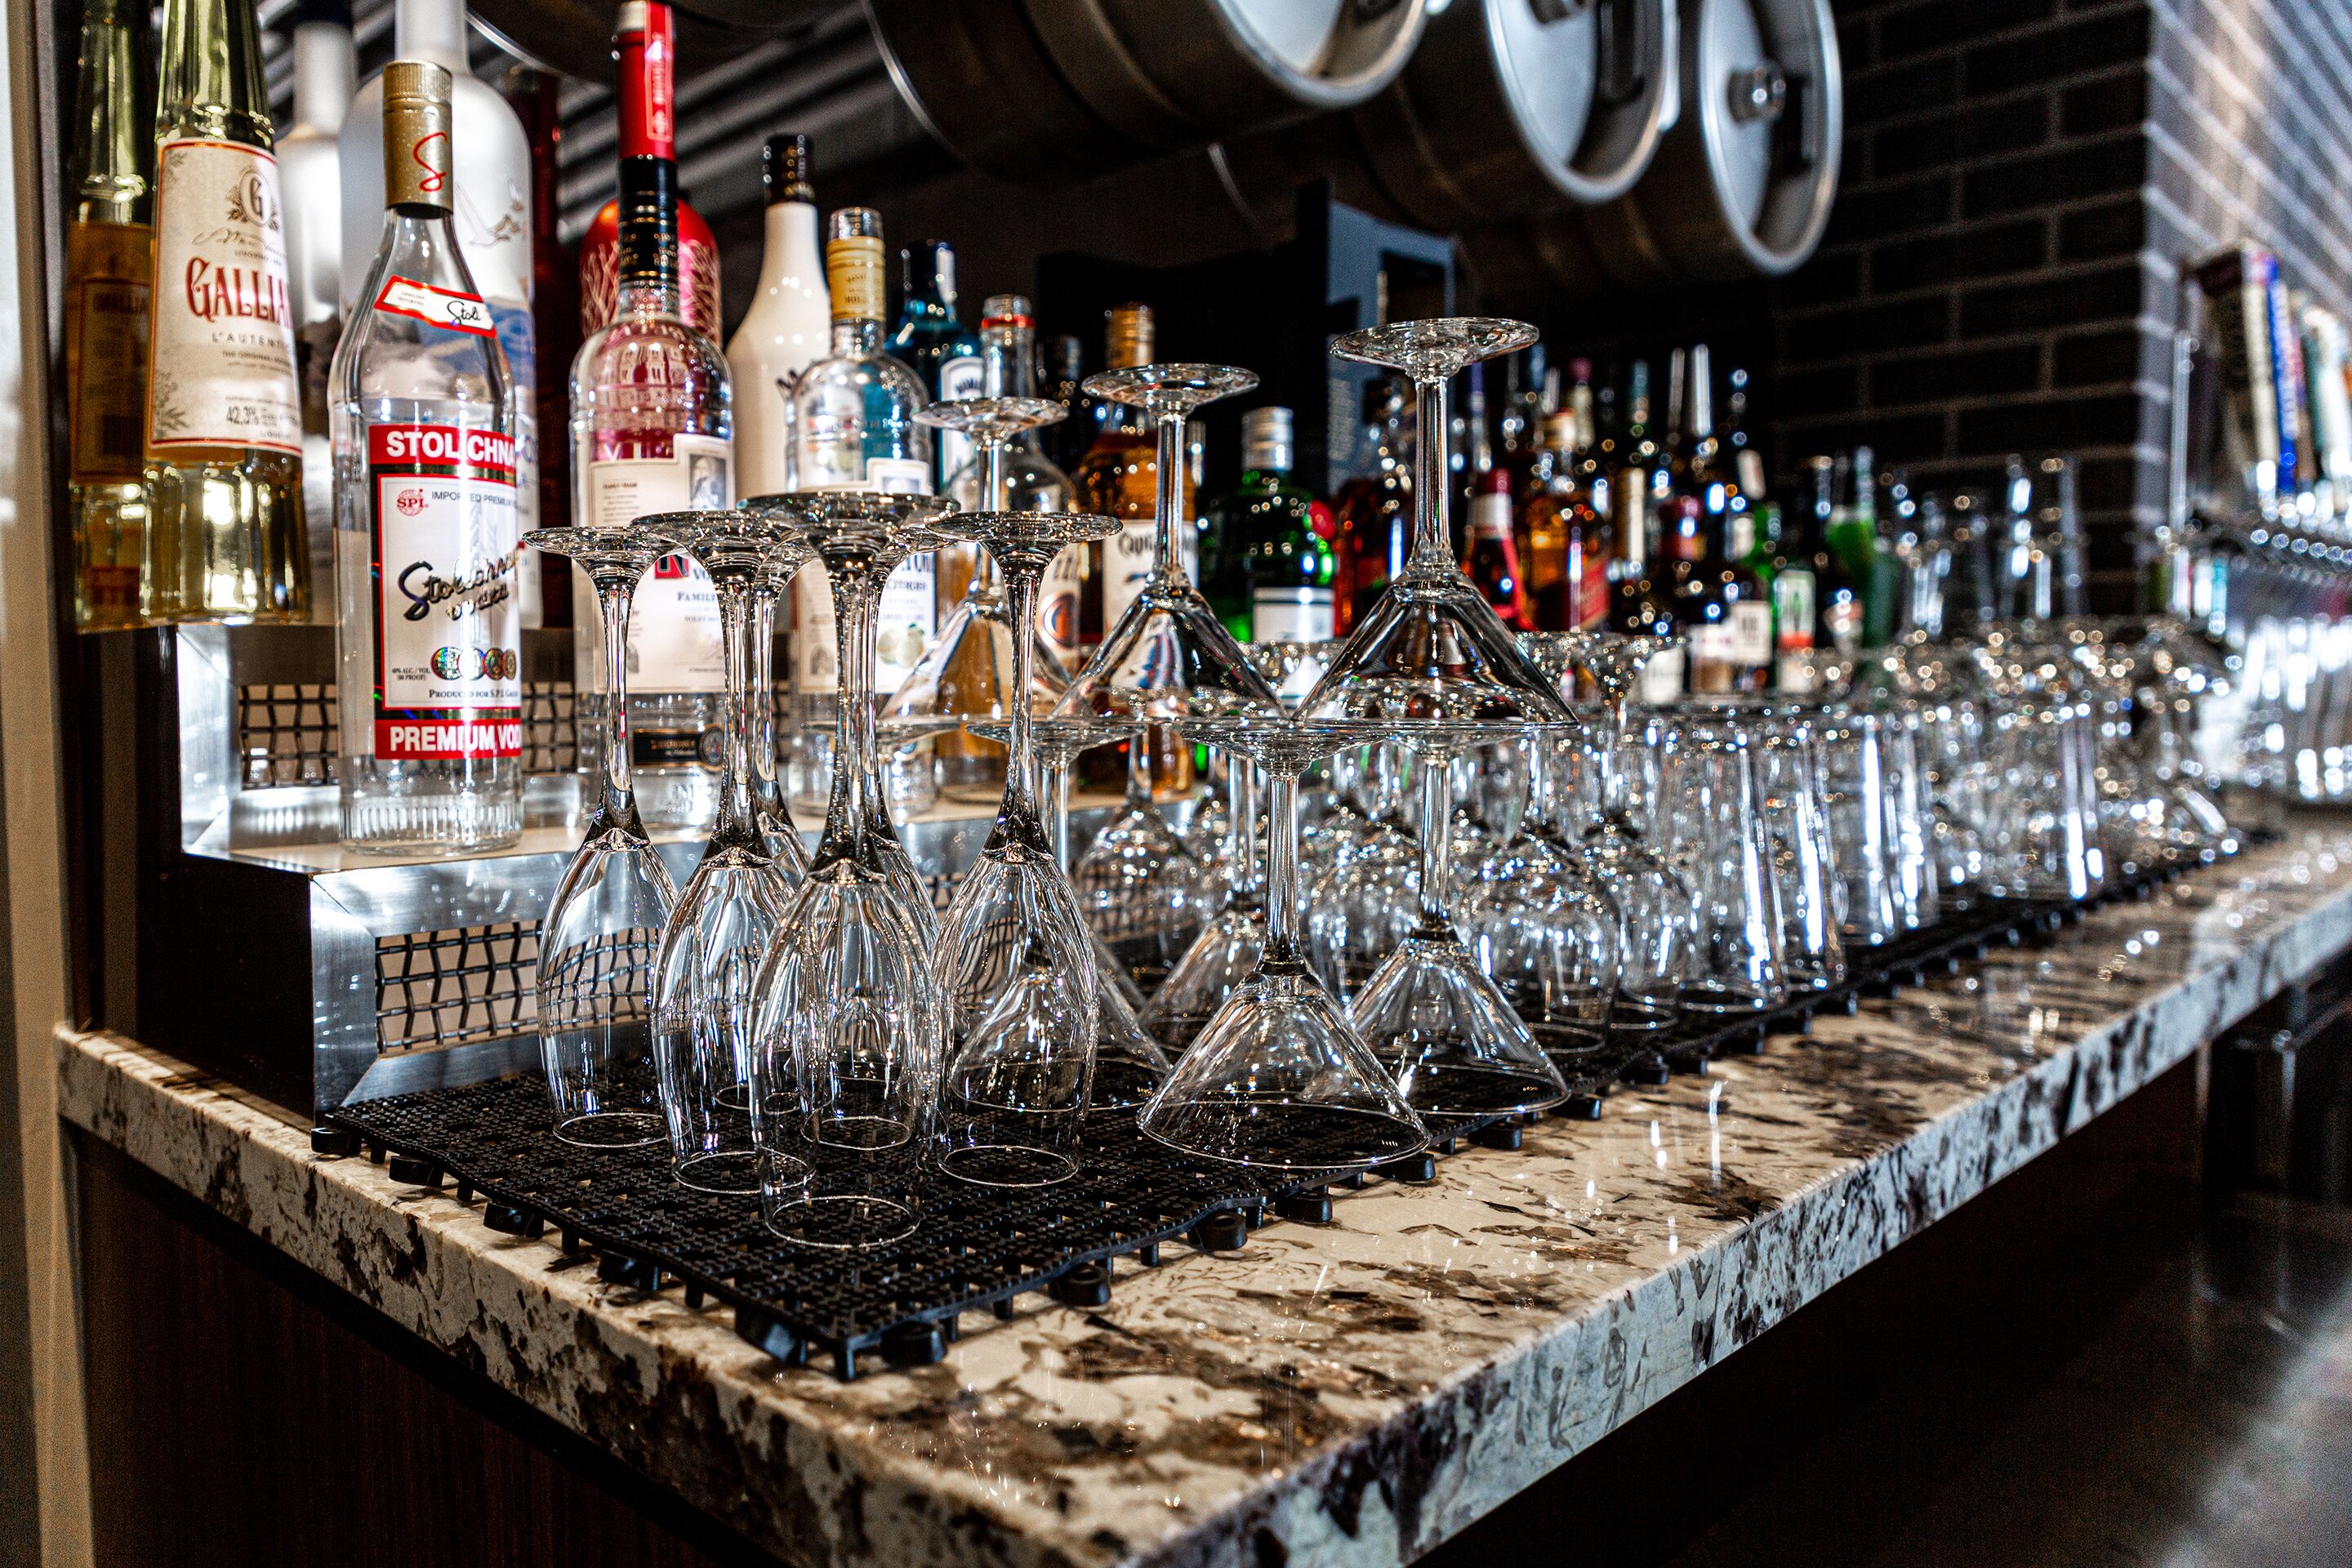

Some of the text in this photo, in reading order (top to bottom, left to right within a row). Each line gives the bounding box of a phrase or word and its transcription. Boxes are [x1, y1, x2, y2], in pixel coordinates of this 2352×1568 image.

[447, 301, 481, 326] Stoli
[386, 430, 516, 467] STOLCHNA
[397, 497, 424, 509] SPI
[432, 492, 482, 503] IMPOED
[429, 689, 474, 698] PRODUCD
[390, 724, 494, 752] PREMIUM
